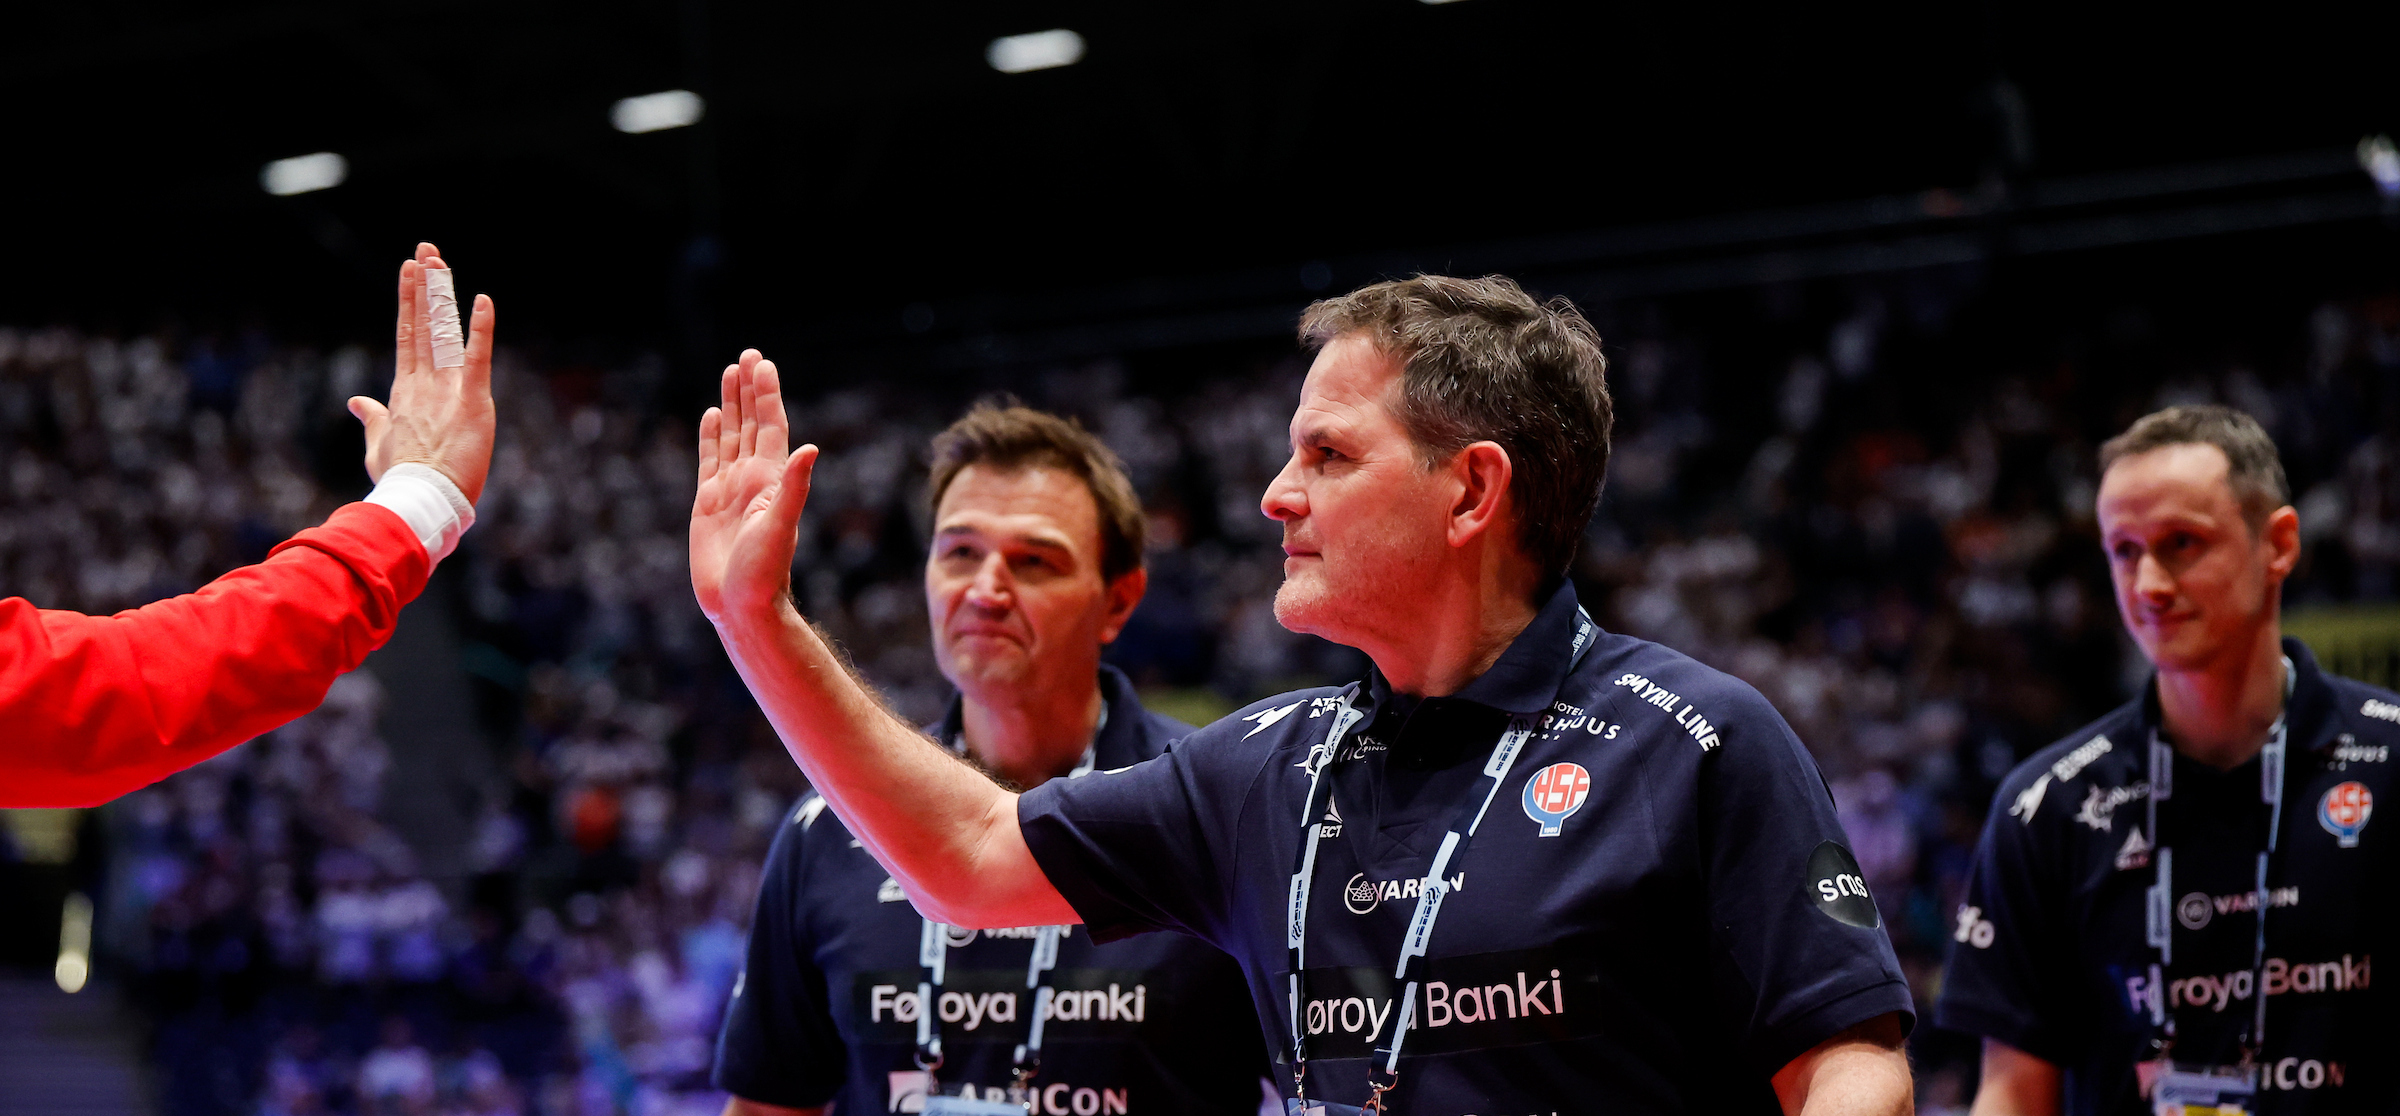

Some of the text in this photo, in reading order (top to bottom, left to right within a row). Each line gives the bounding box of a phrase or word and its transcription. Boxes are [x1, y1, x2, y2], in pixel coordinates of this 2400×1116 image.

[1540, 714, 1621, 740] RHUUS
[1614, 673, 1721, 752] SMYRIL LINE
[1534, 764, 1589, 812] HSF
[1319, 824, 1343, 839] ECT
[1371, 871, 1465, 902] VARN
[1817, 873, 1868, 902] sms
[1290, 969, 1564, 1043] øroy Banki
[2126, 953, 2371, 1013] Froya Banki
[871, 984, 1017, 1031] Føoya
